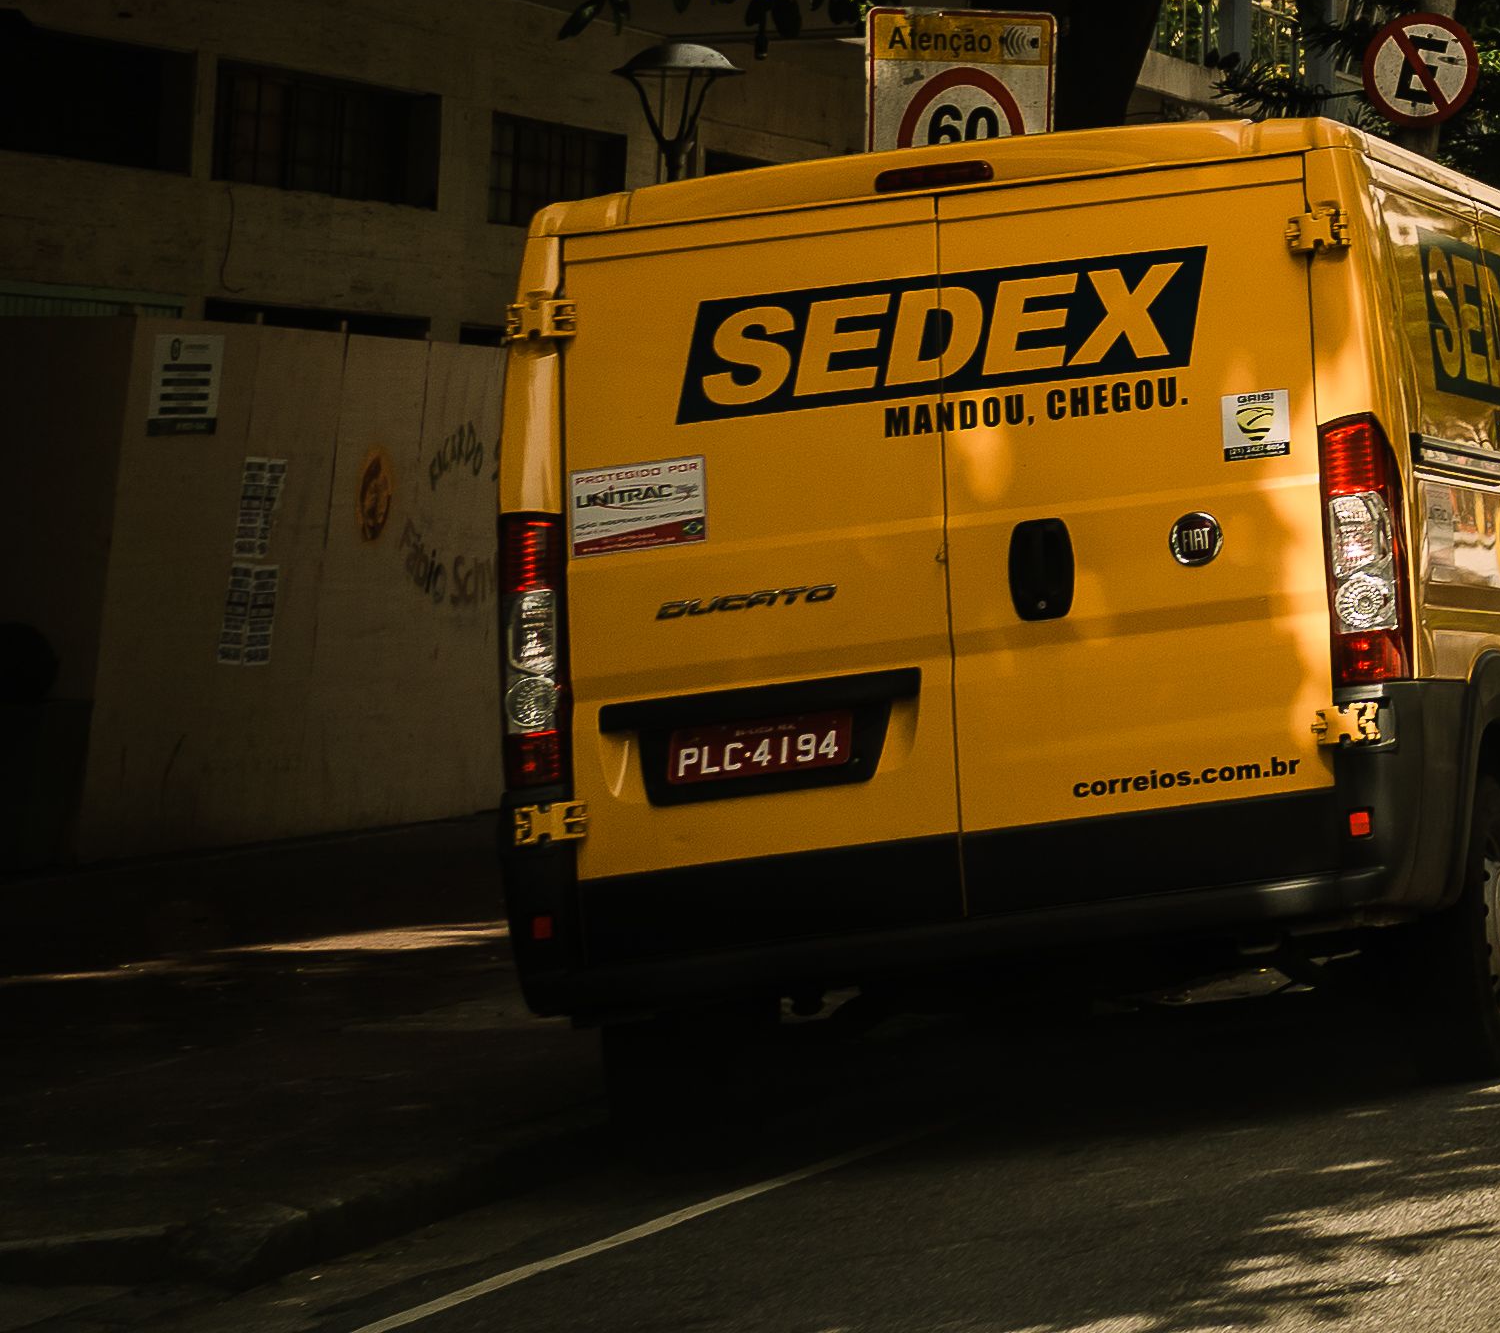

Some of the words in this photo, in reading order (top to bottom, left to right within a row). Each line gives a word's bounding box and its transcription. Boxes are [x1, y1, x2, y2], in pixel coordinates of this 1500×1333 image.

[888, 25, 992, 58] Atenção
[927, 104, 1000, 145] 60
[701, 261, 1186, 406] SEDEX
[884, 393, 1035, 438] MANDOU,
[1045, 376, 1189, 421] CHEGOU.
[575, 467, 662, 485] PROTEGIDO
[667, 462, 699, 474] POR
[576, 484, 673, 509] UNITRAC
[1182, 527, 1210, 552] FIAT
[655, 584, 837, 620] DUCATO
[1072, 756, 1301, 799] correios.com.br
